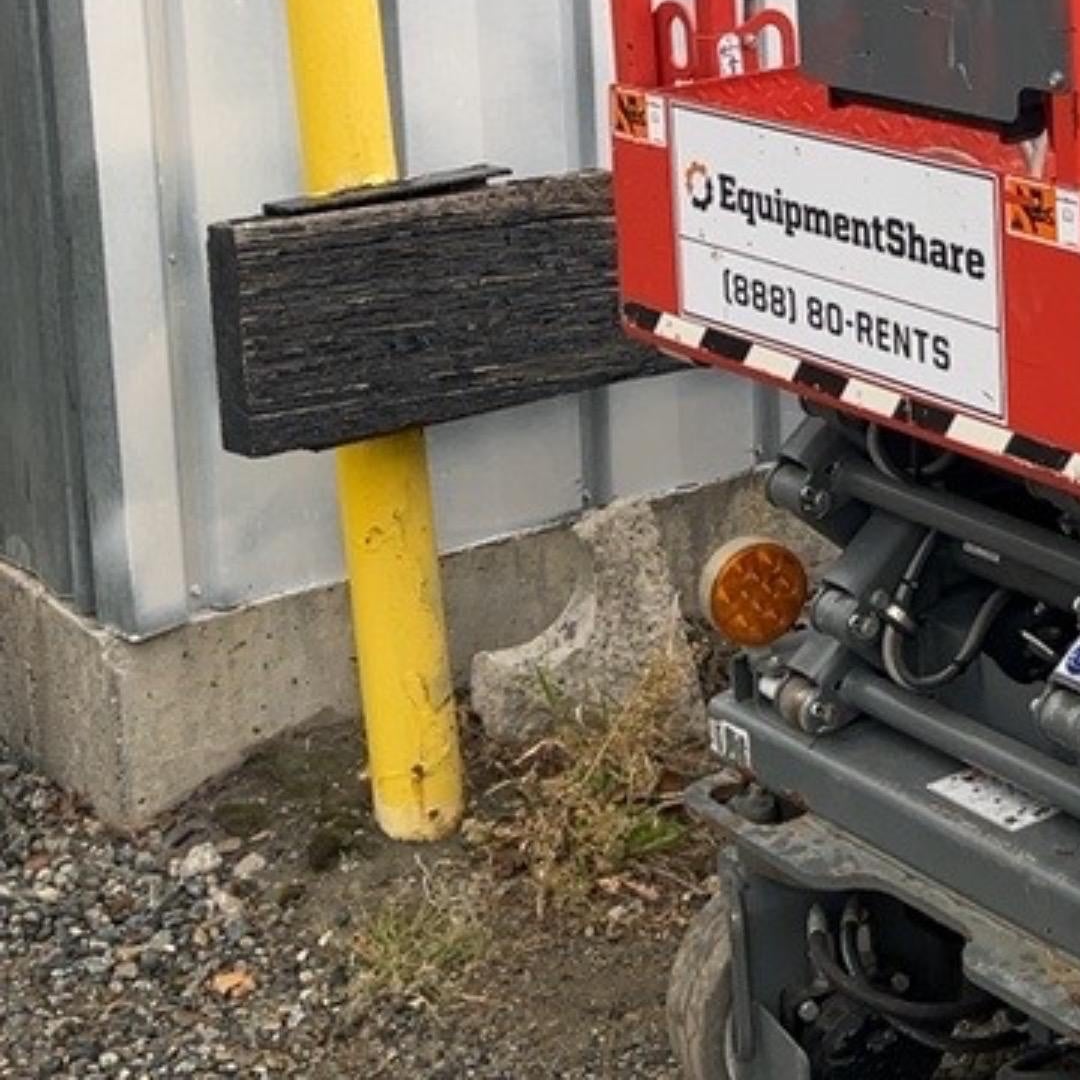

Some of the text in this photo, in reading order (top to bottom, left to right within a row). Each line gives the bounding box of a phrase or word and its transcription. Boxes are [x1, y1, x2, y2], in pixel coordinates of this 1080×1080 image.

[717, 173, 986, 281] EquipmentShare
[722, 268, 951, 371] (888) 80-RENTS
